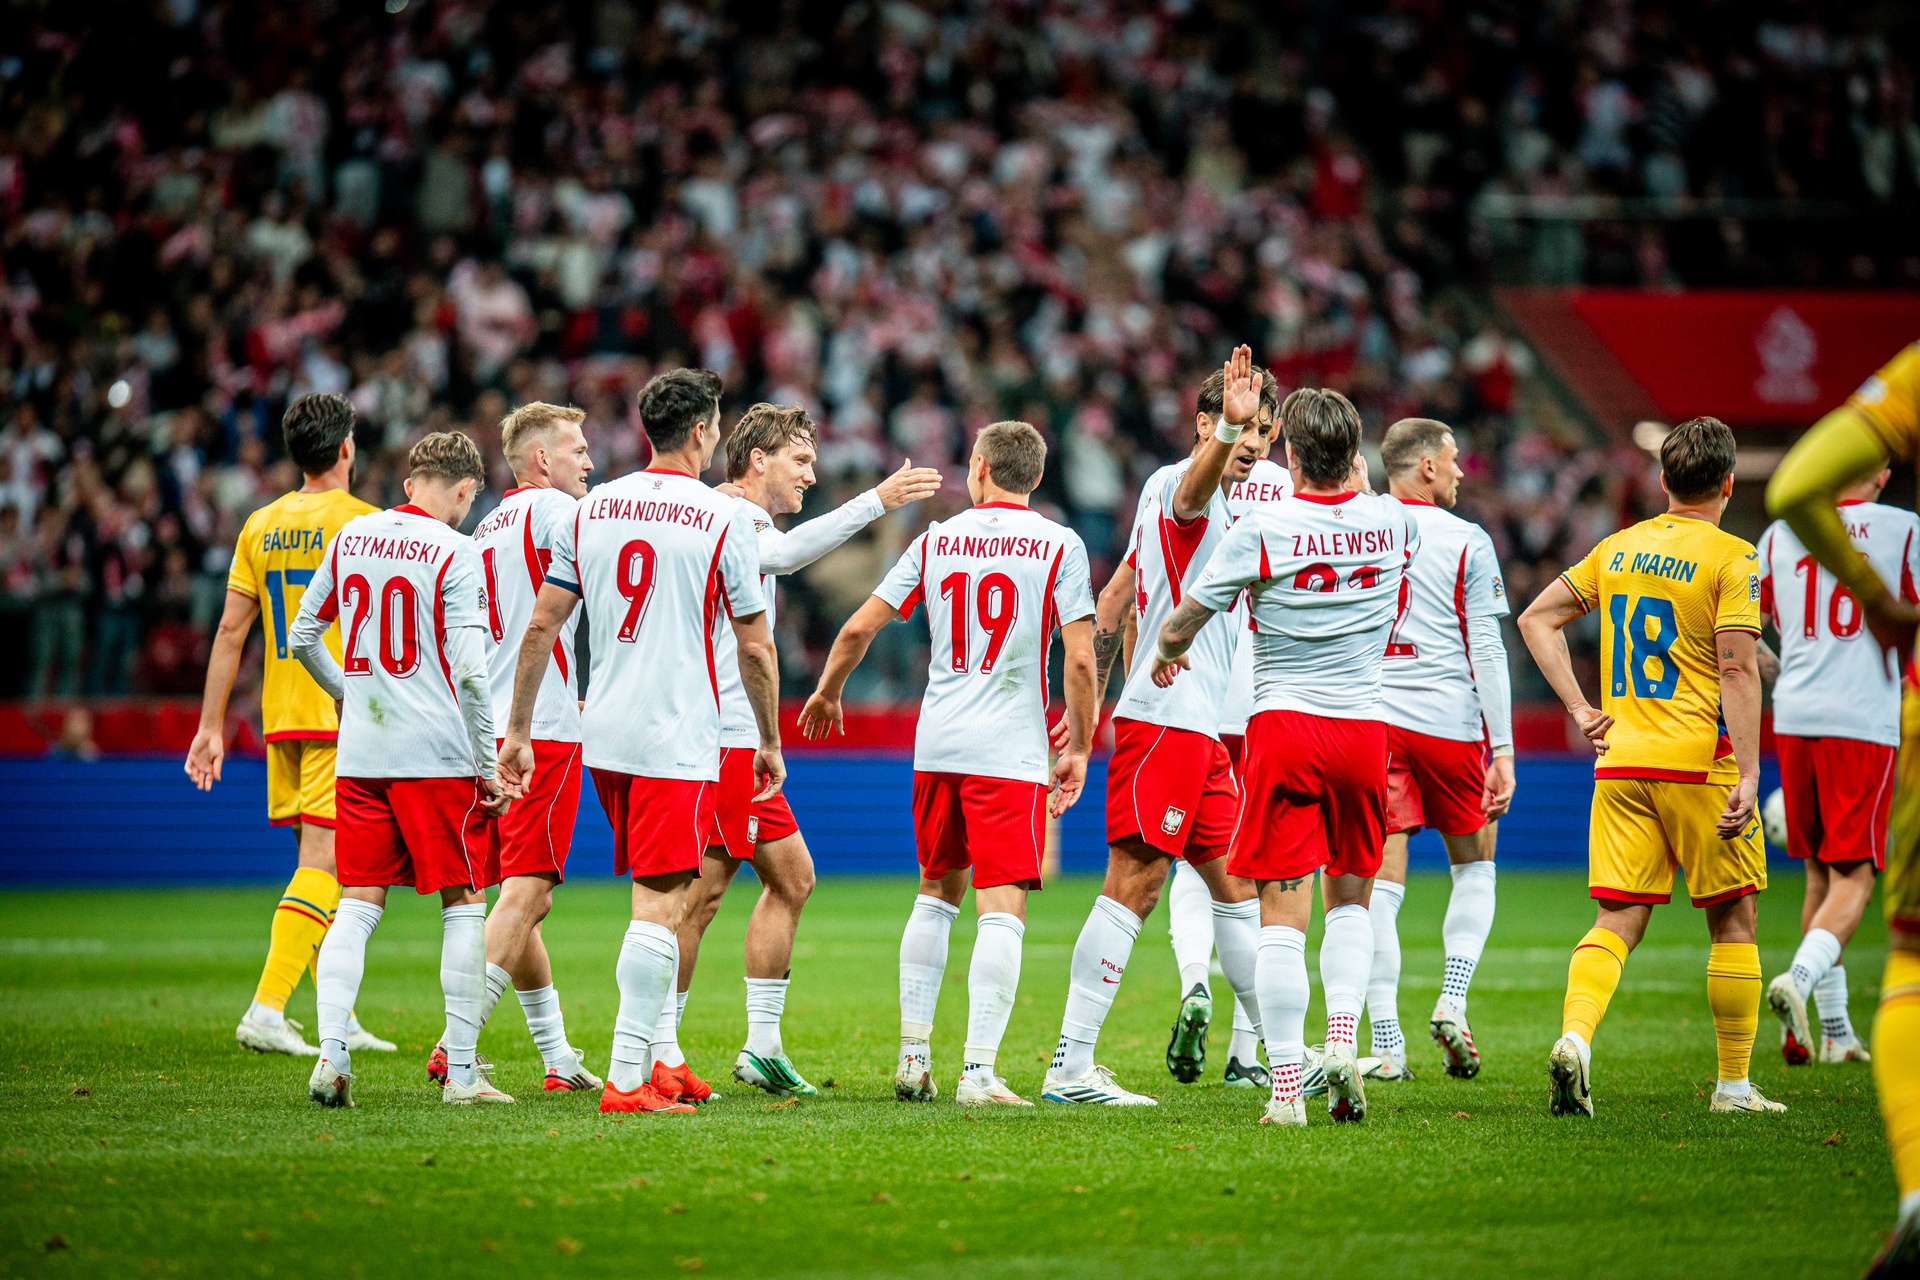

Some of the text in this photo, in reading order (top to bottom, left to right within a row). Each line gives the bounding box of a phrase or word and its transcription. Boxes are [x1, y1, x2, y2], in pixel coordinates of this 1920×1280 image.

[589, 497, 715, 532] LEWANDOWSKI
[263, 527, 323, 555] BĂLUȚĂ
[342, 535, 441, 565] SZYMAŃSKI
[935, 536, 1051, 561] RANKOWSKI
[1291, 528, 1395, 557] ZALEWSKI
[1608, 551, 1698, 583] R. MARIN
[616, 539, 658, 643] 9
[1795, 552, 1869, 642] 16
[342, 573, 421, 680] 20
[940, 571, 1019, 675] 19
[1609, 593, 1680, 700] 18
[1101, 957, 1124, 974] POLS
